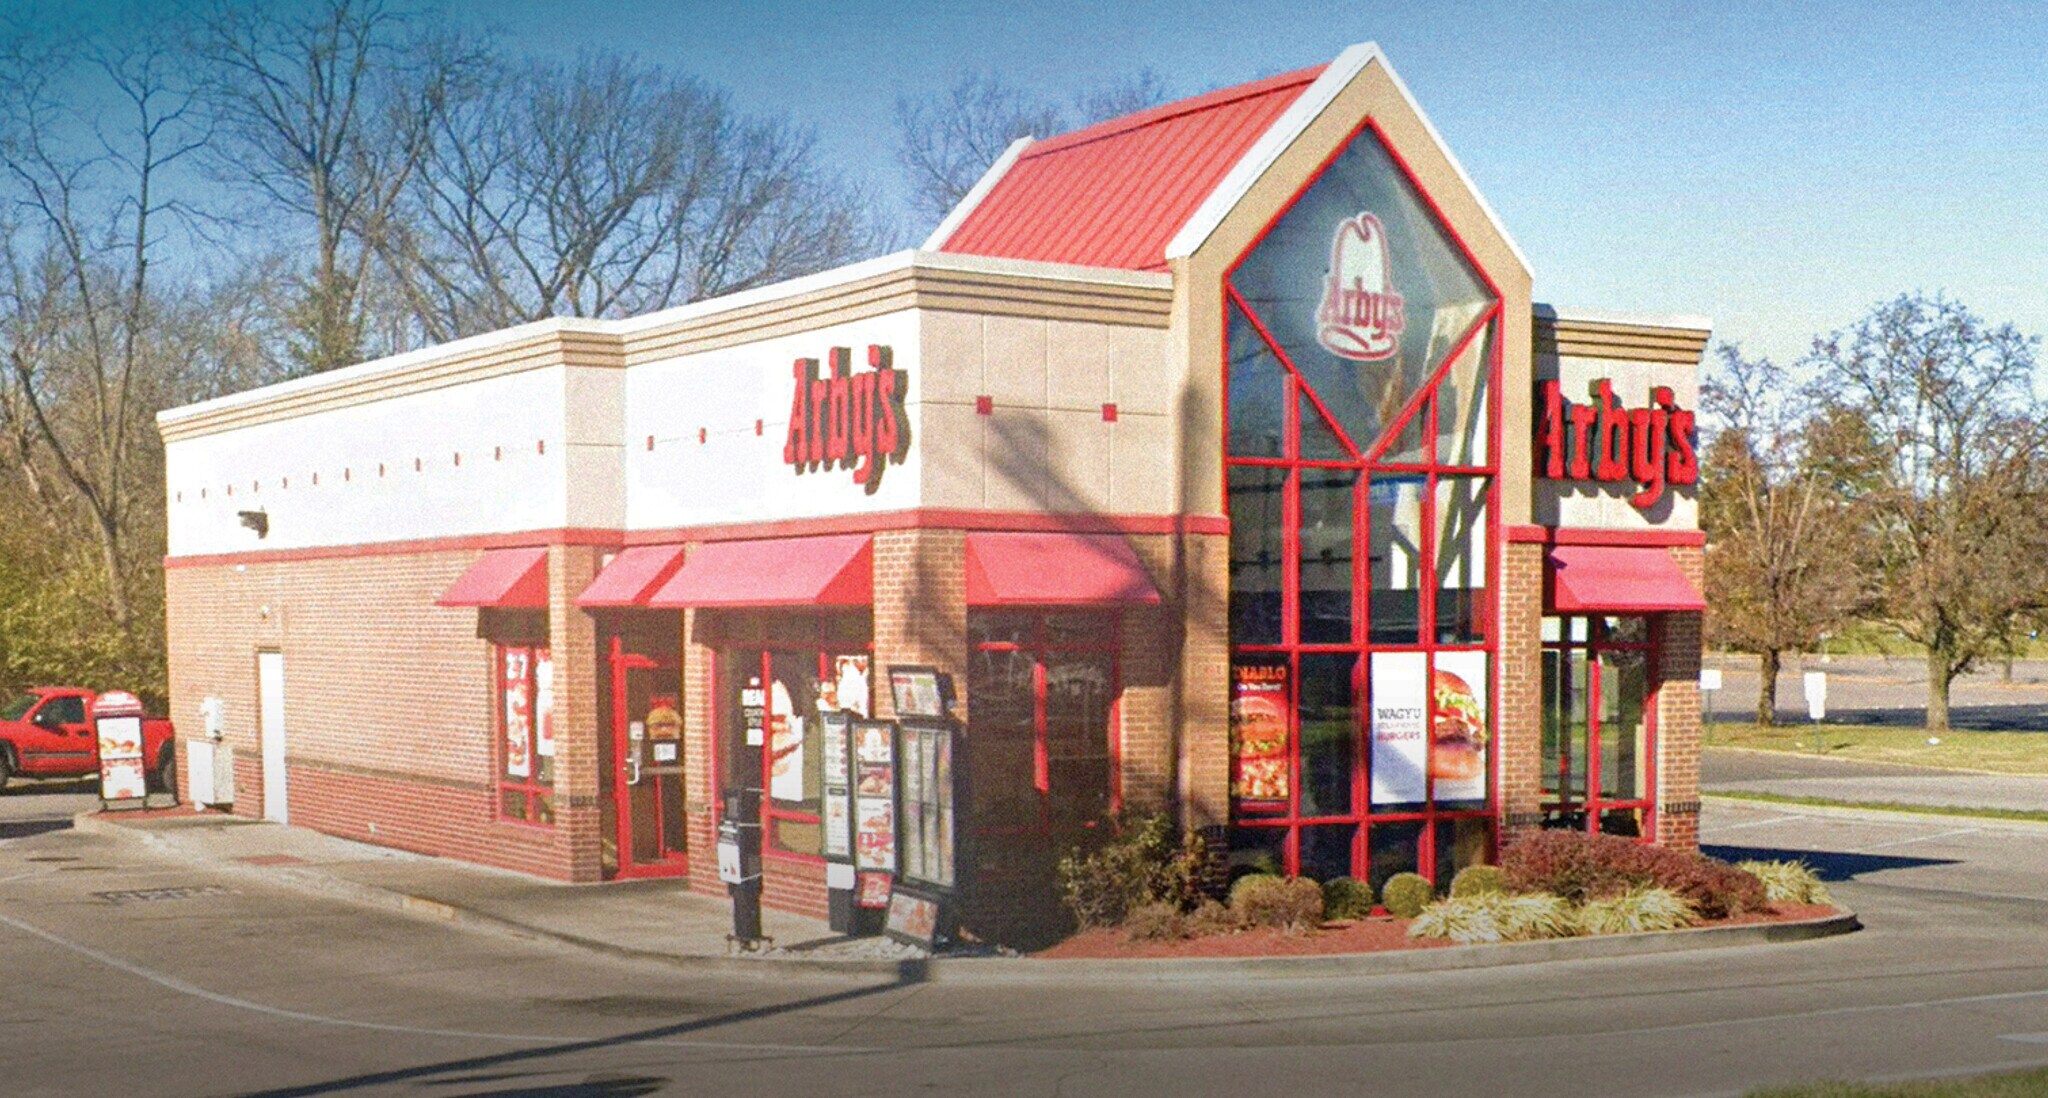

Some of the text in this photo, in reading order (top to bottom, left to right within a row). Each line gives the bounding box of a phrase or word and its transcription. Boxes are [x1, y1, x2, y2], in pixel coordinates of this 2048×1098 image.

[784, 344, 899, 485] Arby's
[1534, 378, 1698, 509] Arby's
[1377, 708, 1421, 719] WAGYU
